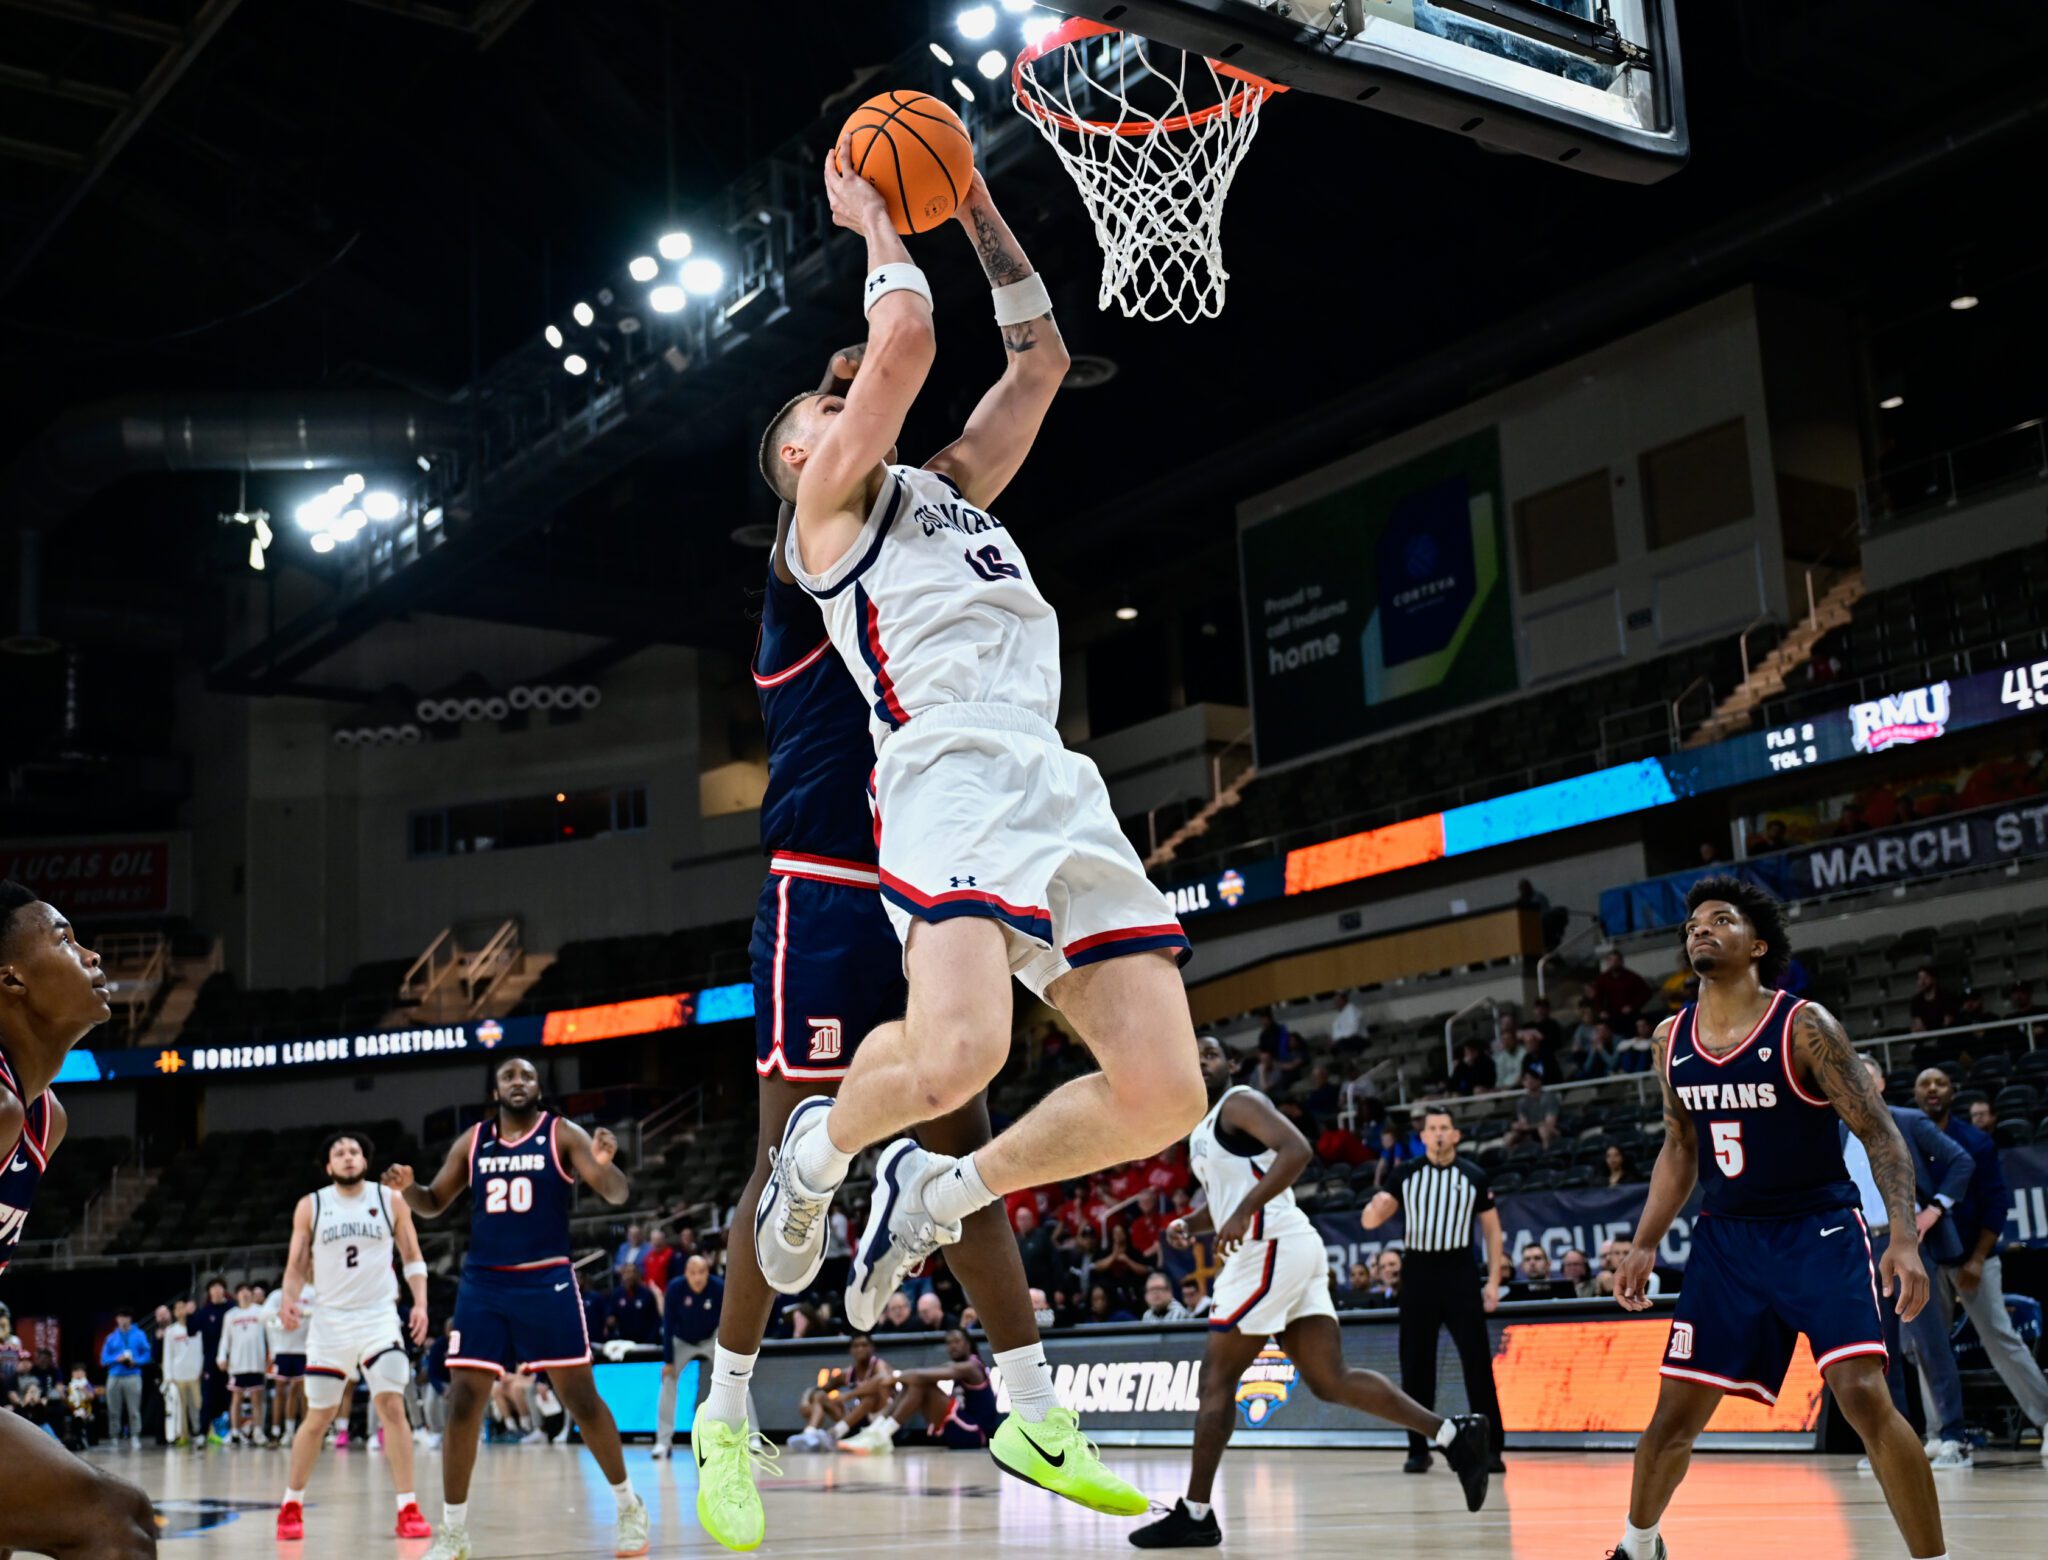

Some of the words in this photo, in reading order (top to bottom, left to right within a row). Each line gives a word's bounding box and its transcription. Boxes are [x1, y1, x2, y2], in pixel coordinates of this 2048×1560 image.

[1264, 587, 1304, 616] Proud
[1306, 584, 1323, 600] to
[1392, 576, 1456, 608] CORTEVA
[1268, 632, 1341, 676] home
[2001, 661, 2048, 710] 45
[1851, 682, 1949, 747] RMU
[1769, 750, 1802, 771] TOL
[8, 853, 102, 880] LUCAS
[110, 850, 154, 877] OIL
[1809, 822, 1972, 889] MARCH
[192, 1045, 277, 1070] HORIZON
[282, 1037, 349, 1064] LEAGUE
[354, 1027, 467, 1057] BASKETBALL
[1676, 1083, 1777, 1110] TITANS
[478, 1154, 545, 1174] TITANS
[1709, 1120, 1744, 1179] 5
[486, 1176, 533, 1214] 20
[322, 1222, 383, 1245] COLONIALS
[345, 1245, 359, 1268] 2
[1054, 1360, 1201, 1412] BASKETBAL
